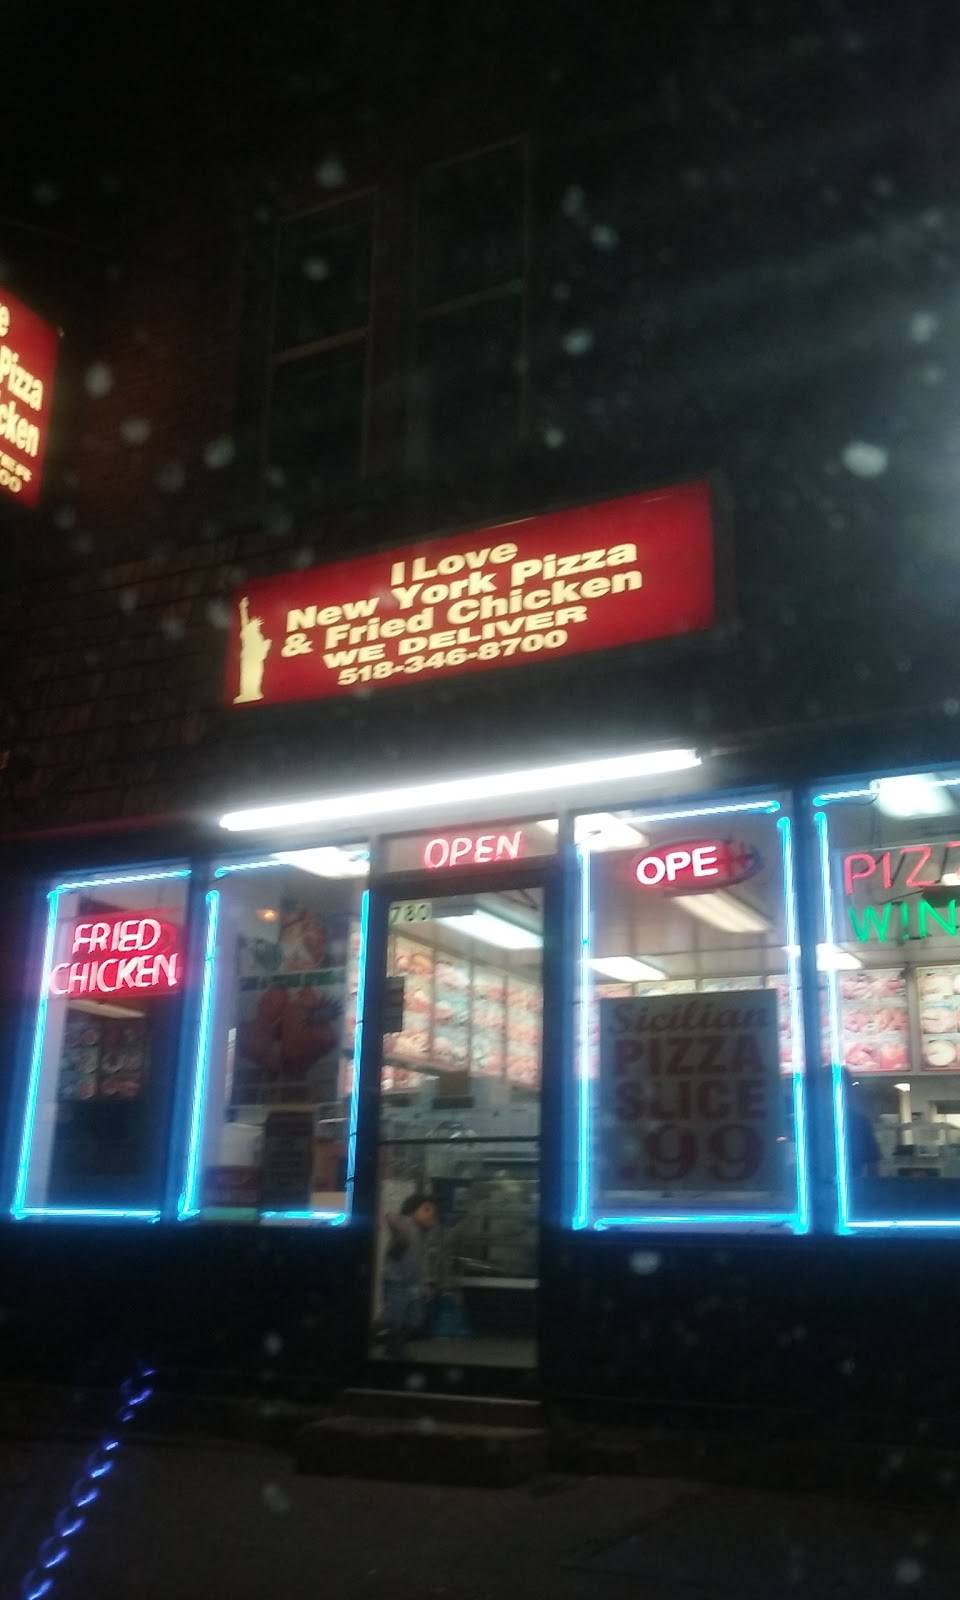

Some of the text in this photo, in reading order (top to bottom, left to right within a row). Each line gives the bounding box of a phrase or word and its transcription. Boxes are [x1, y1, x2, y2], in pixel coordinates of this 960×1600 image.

[391, 543, 518, 586] I Love
[286, 543, 638, 633] New York Pizza
[281, 570, 643, 657] & Fried Chicken
[323, 605, 589, 669] WE DELIVER
[337, 629, 568, 686] 518-346-8700
[424, 831, 522, 868] OPEN
[72, 918, 162, 954] FRIED
[50, 952, 179, 995] CHICKEN
[608, 1000, 768, 1033] Sicilian
[614, 1033, 764, 1077] PIZZA
[617, 1079, 767, 1121] SLICE
